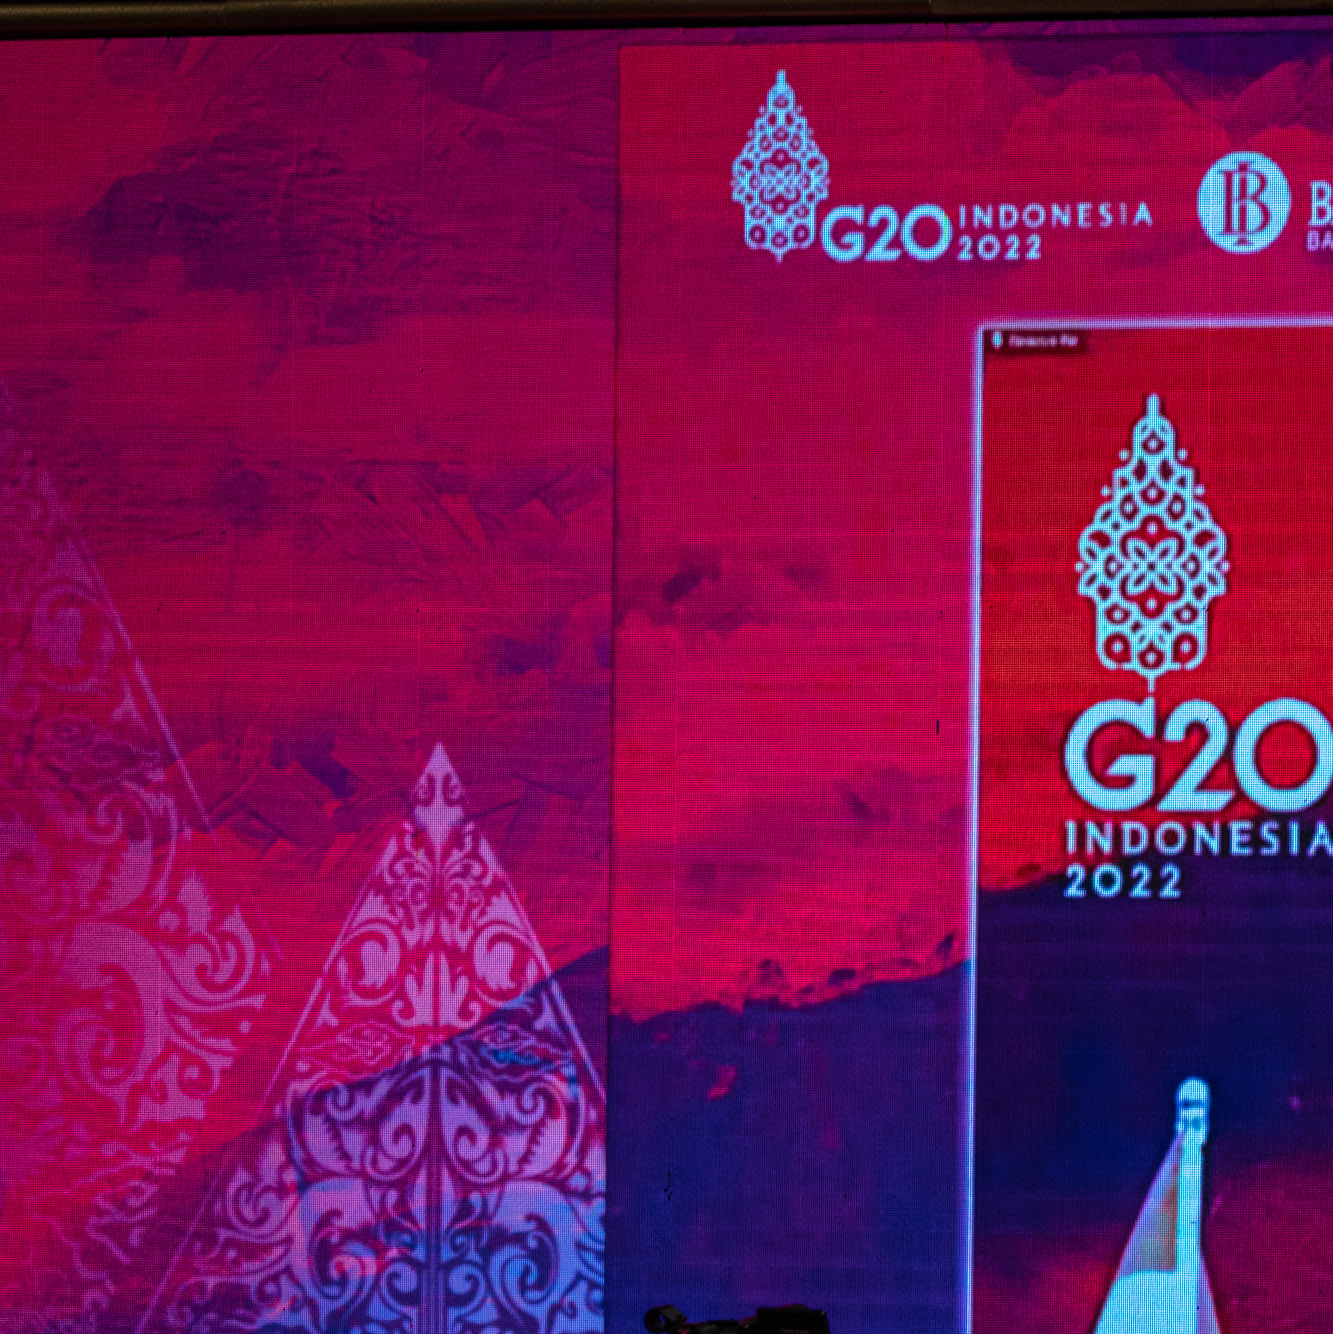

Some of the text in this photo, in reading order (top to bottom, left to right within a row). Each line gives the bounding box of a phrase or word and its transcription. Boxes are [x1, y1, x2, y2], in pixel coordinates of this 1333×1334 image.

[820, 203, 952, 262] G20
[959, 202, 1152, 228] INDONESIA
[958, 234, 1041, 261] 2022
[1066, 820, 1333, 855] INDONESIA
[1065, 863, 1180, 898] 2022
